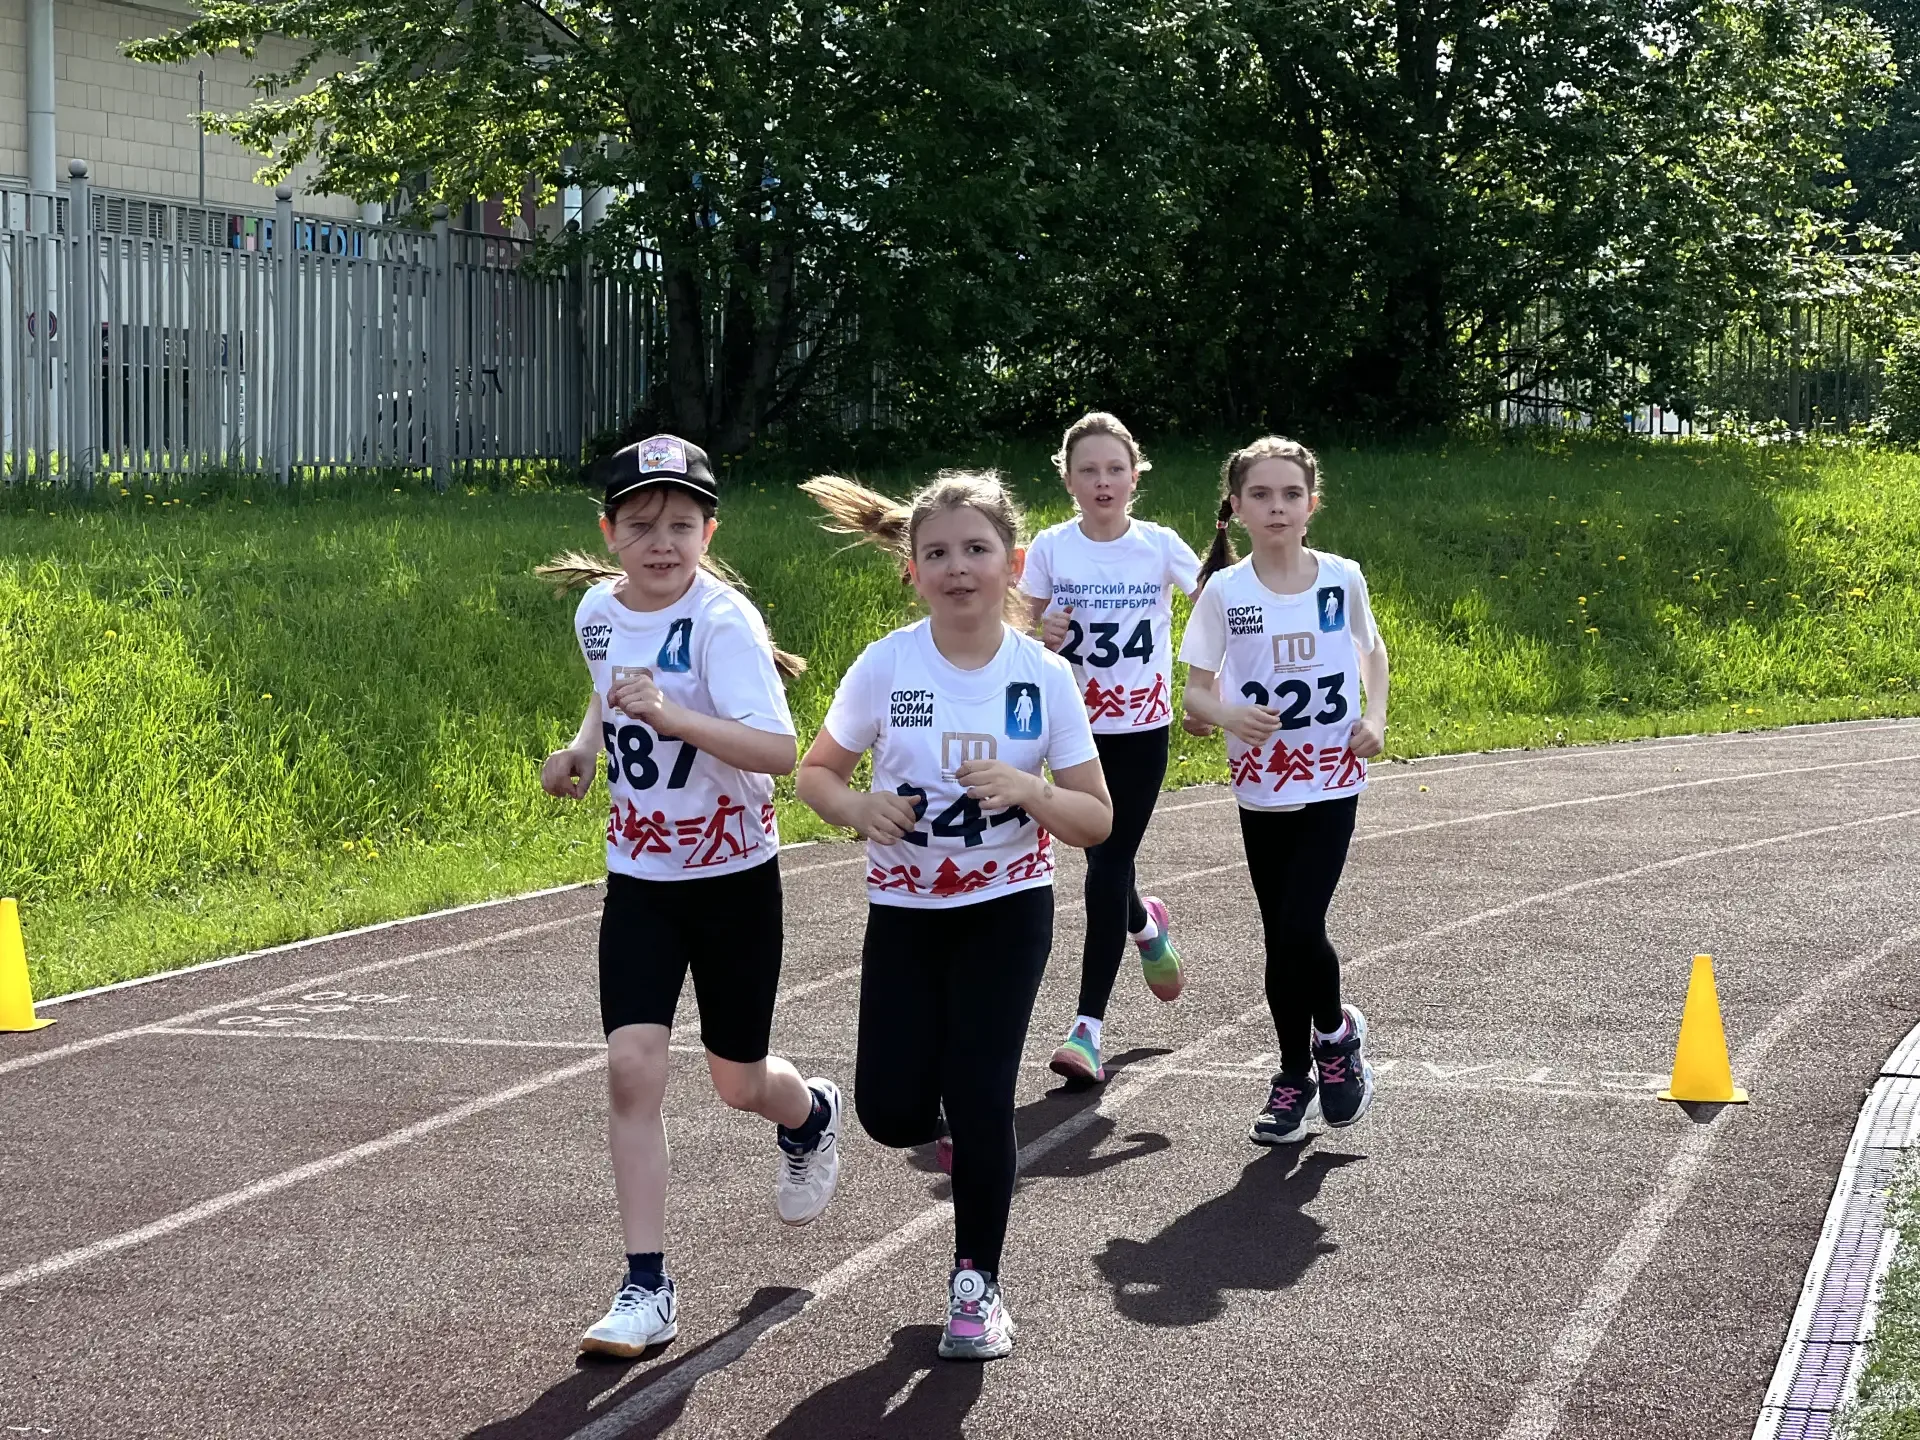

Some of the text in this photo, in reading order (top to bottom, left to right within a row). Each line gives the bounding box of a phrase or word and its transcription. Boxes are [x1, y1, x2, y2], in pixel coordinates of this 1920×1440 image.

[1053, 583, 1125, 595] ВЫБОРГСКИЙ
[1227, 606, 1255, 616] СПОРТ
[1228, 615, 1263, 626] НОРМА
[582, 624, 607, 637] СПОРТ
[1230, 625, 1264, 635] ЖИЗНИ
[1058, 619, 1154, 668] 234
[1272, 632, 1316, 664] ГТО
[891, 690, 926, 702] СПОРТ
[891, 703, 933, 715] НОРМА
[890, 716, 933, 727] ЖИЗНИ
[602, 721, 699, 790] 587
